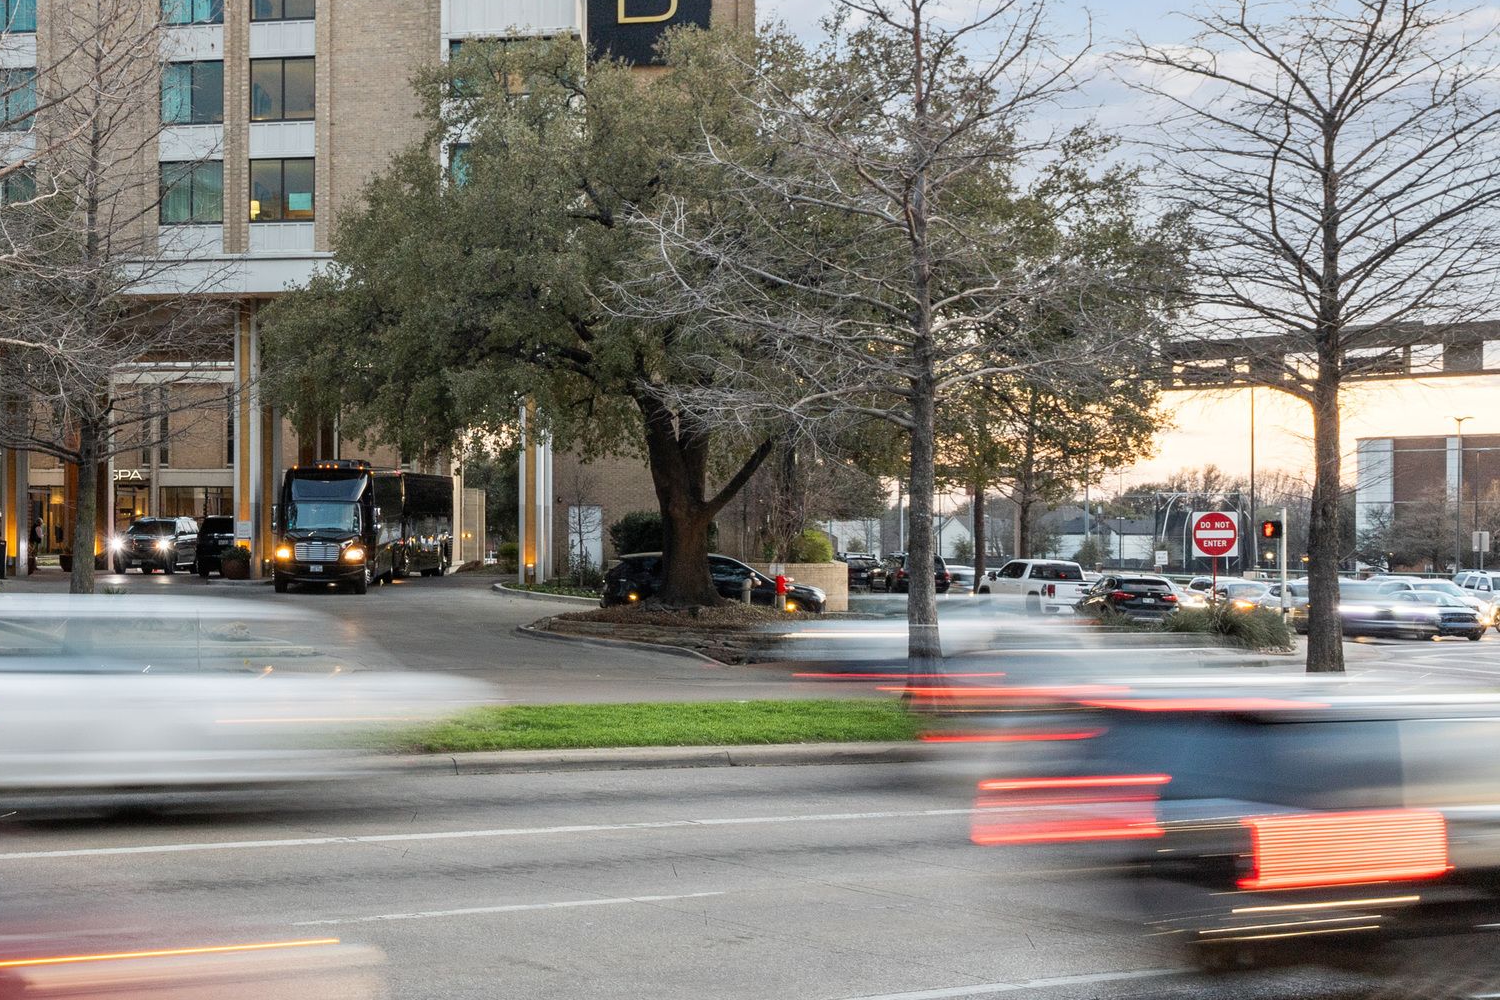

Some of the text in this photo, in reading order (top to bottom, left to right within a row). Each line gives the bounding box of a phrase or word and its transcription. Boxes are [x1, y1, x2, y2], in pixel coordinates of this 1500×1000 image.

[112, 469, 143, 481] SPA
[1200, 521, 1230, 529] DO NOT
[1203, 539, 1227, 548] ENTER
